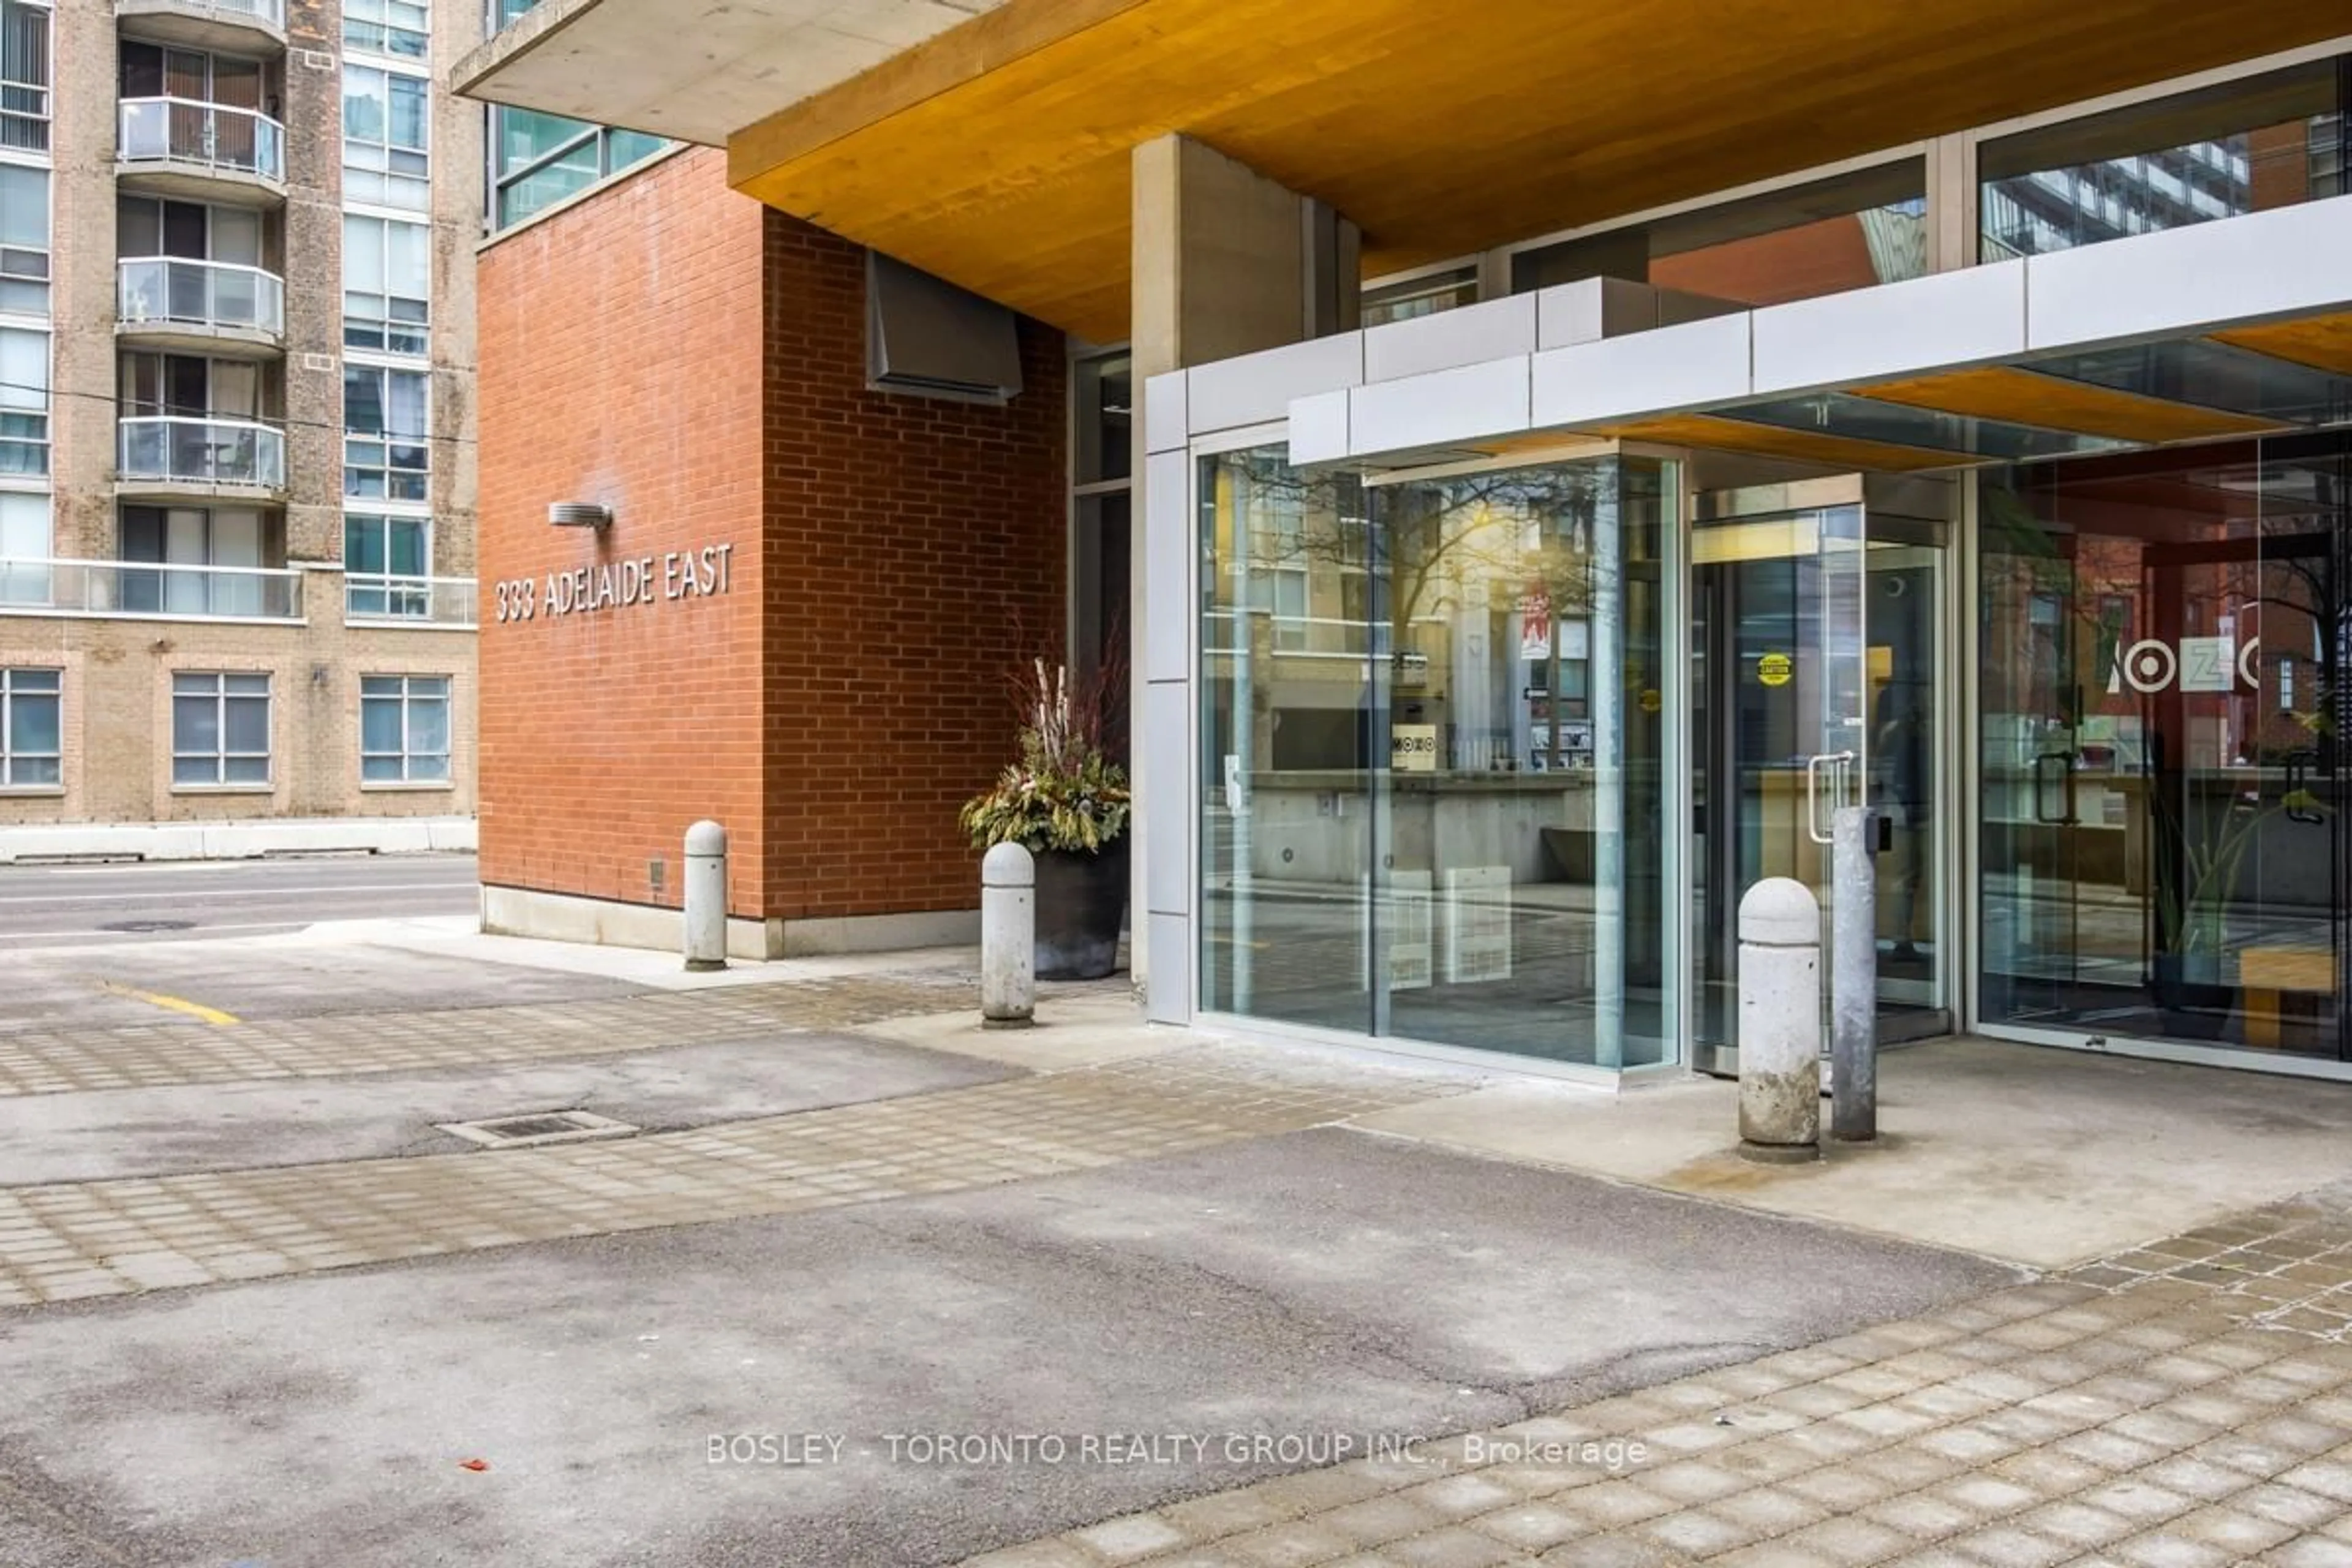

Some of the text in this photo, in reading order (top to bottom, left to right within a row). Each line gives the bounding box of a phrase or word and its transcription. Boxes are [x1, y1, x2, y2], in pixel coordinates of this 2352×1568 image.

[496, 543, 731, 622] 333 ADELAIDE EAST
